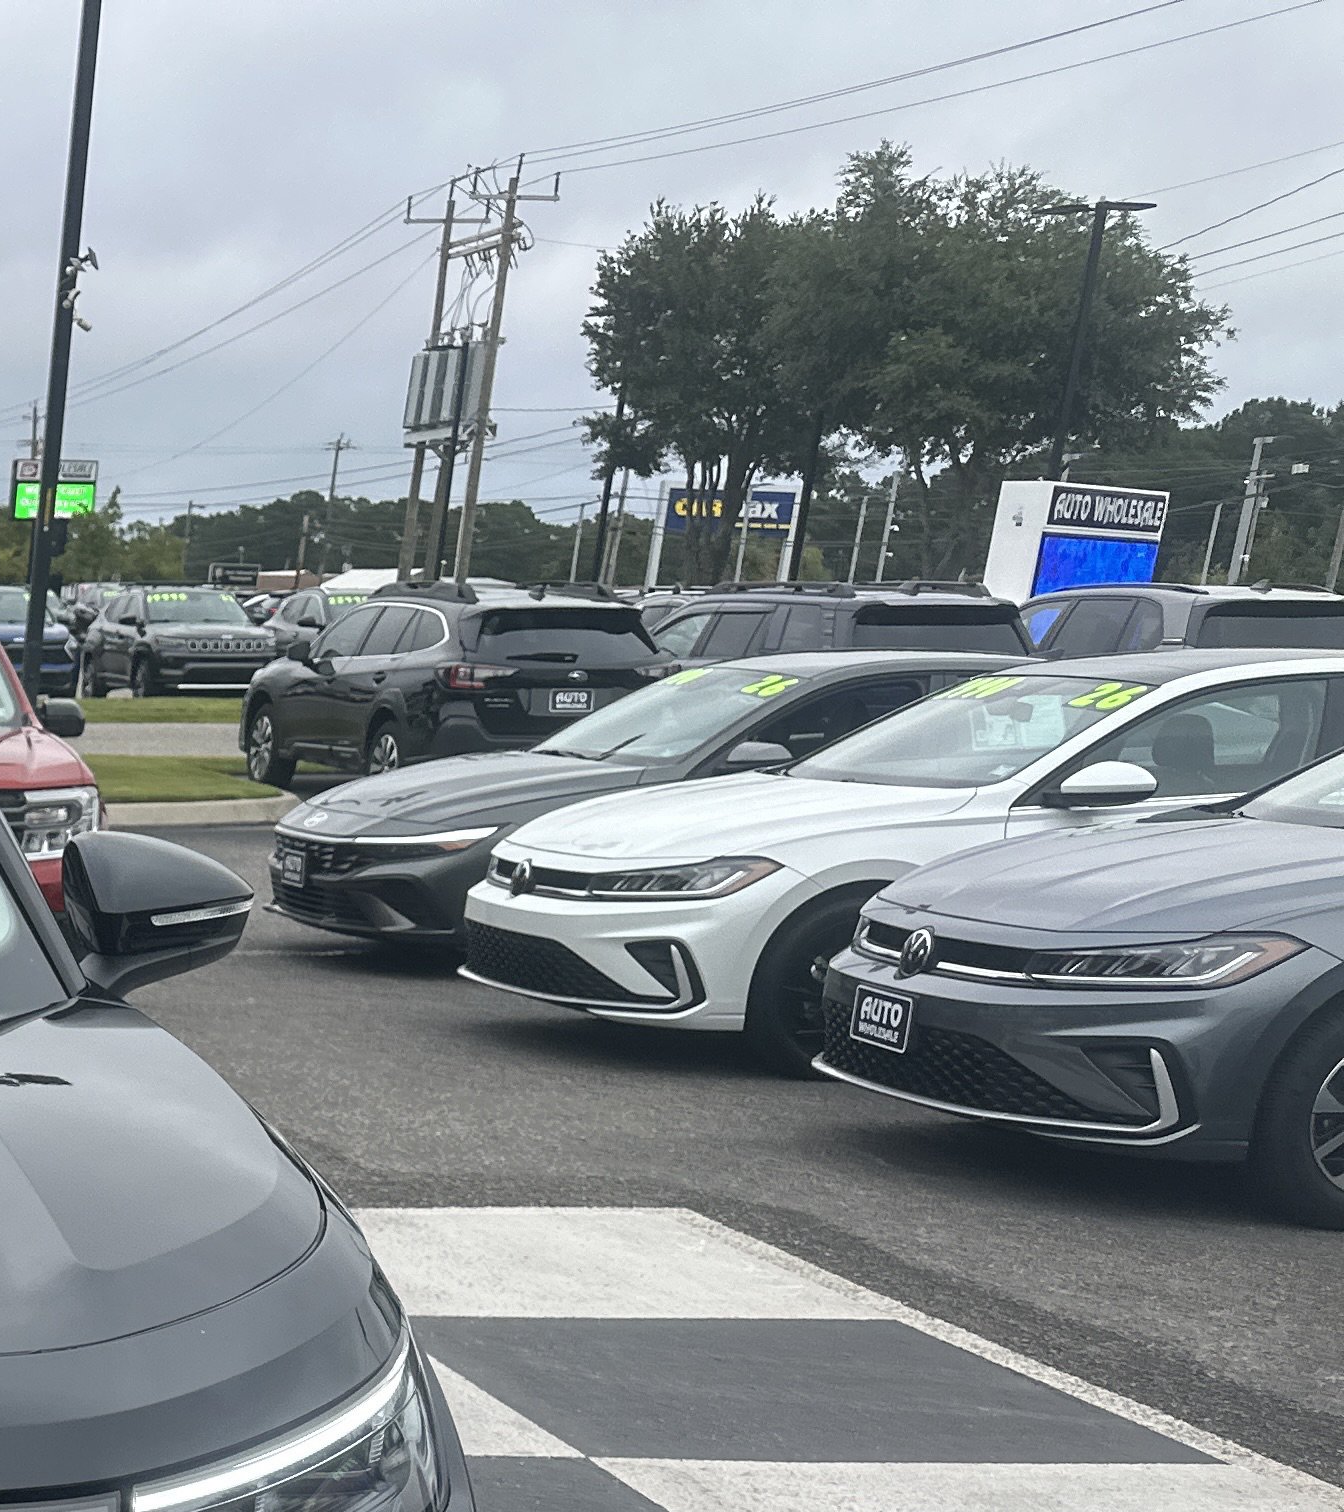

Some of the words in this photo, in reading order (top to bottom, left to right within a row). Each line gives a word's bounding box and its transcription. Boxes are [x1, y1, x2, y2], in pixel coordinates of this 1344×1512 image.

[1053, 492, 1092, 521] AUTO
[1093, 495, 1164, 527] WHOLESALE
[555, 691, 588, 703] AUTO
[740, 674, 799, 698] 26
[1067, 682, 1148, 711] 26
[860, 996, 903, 1028] AUTO
